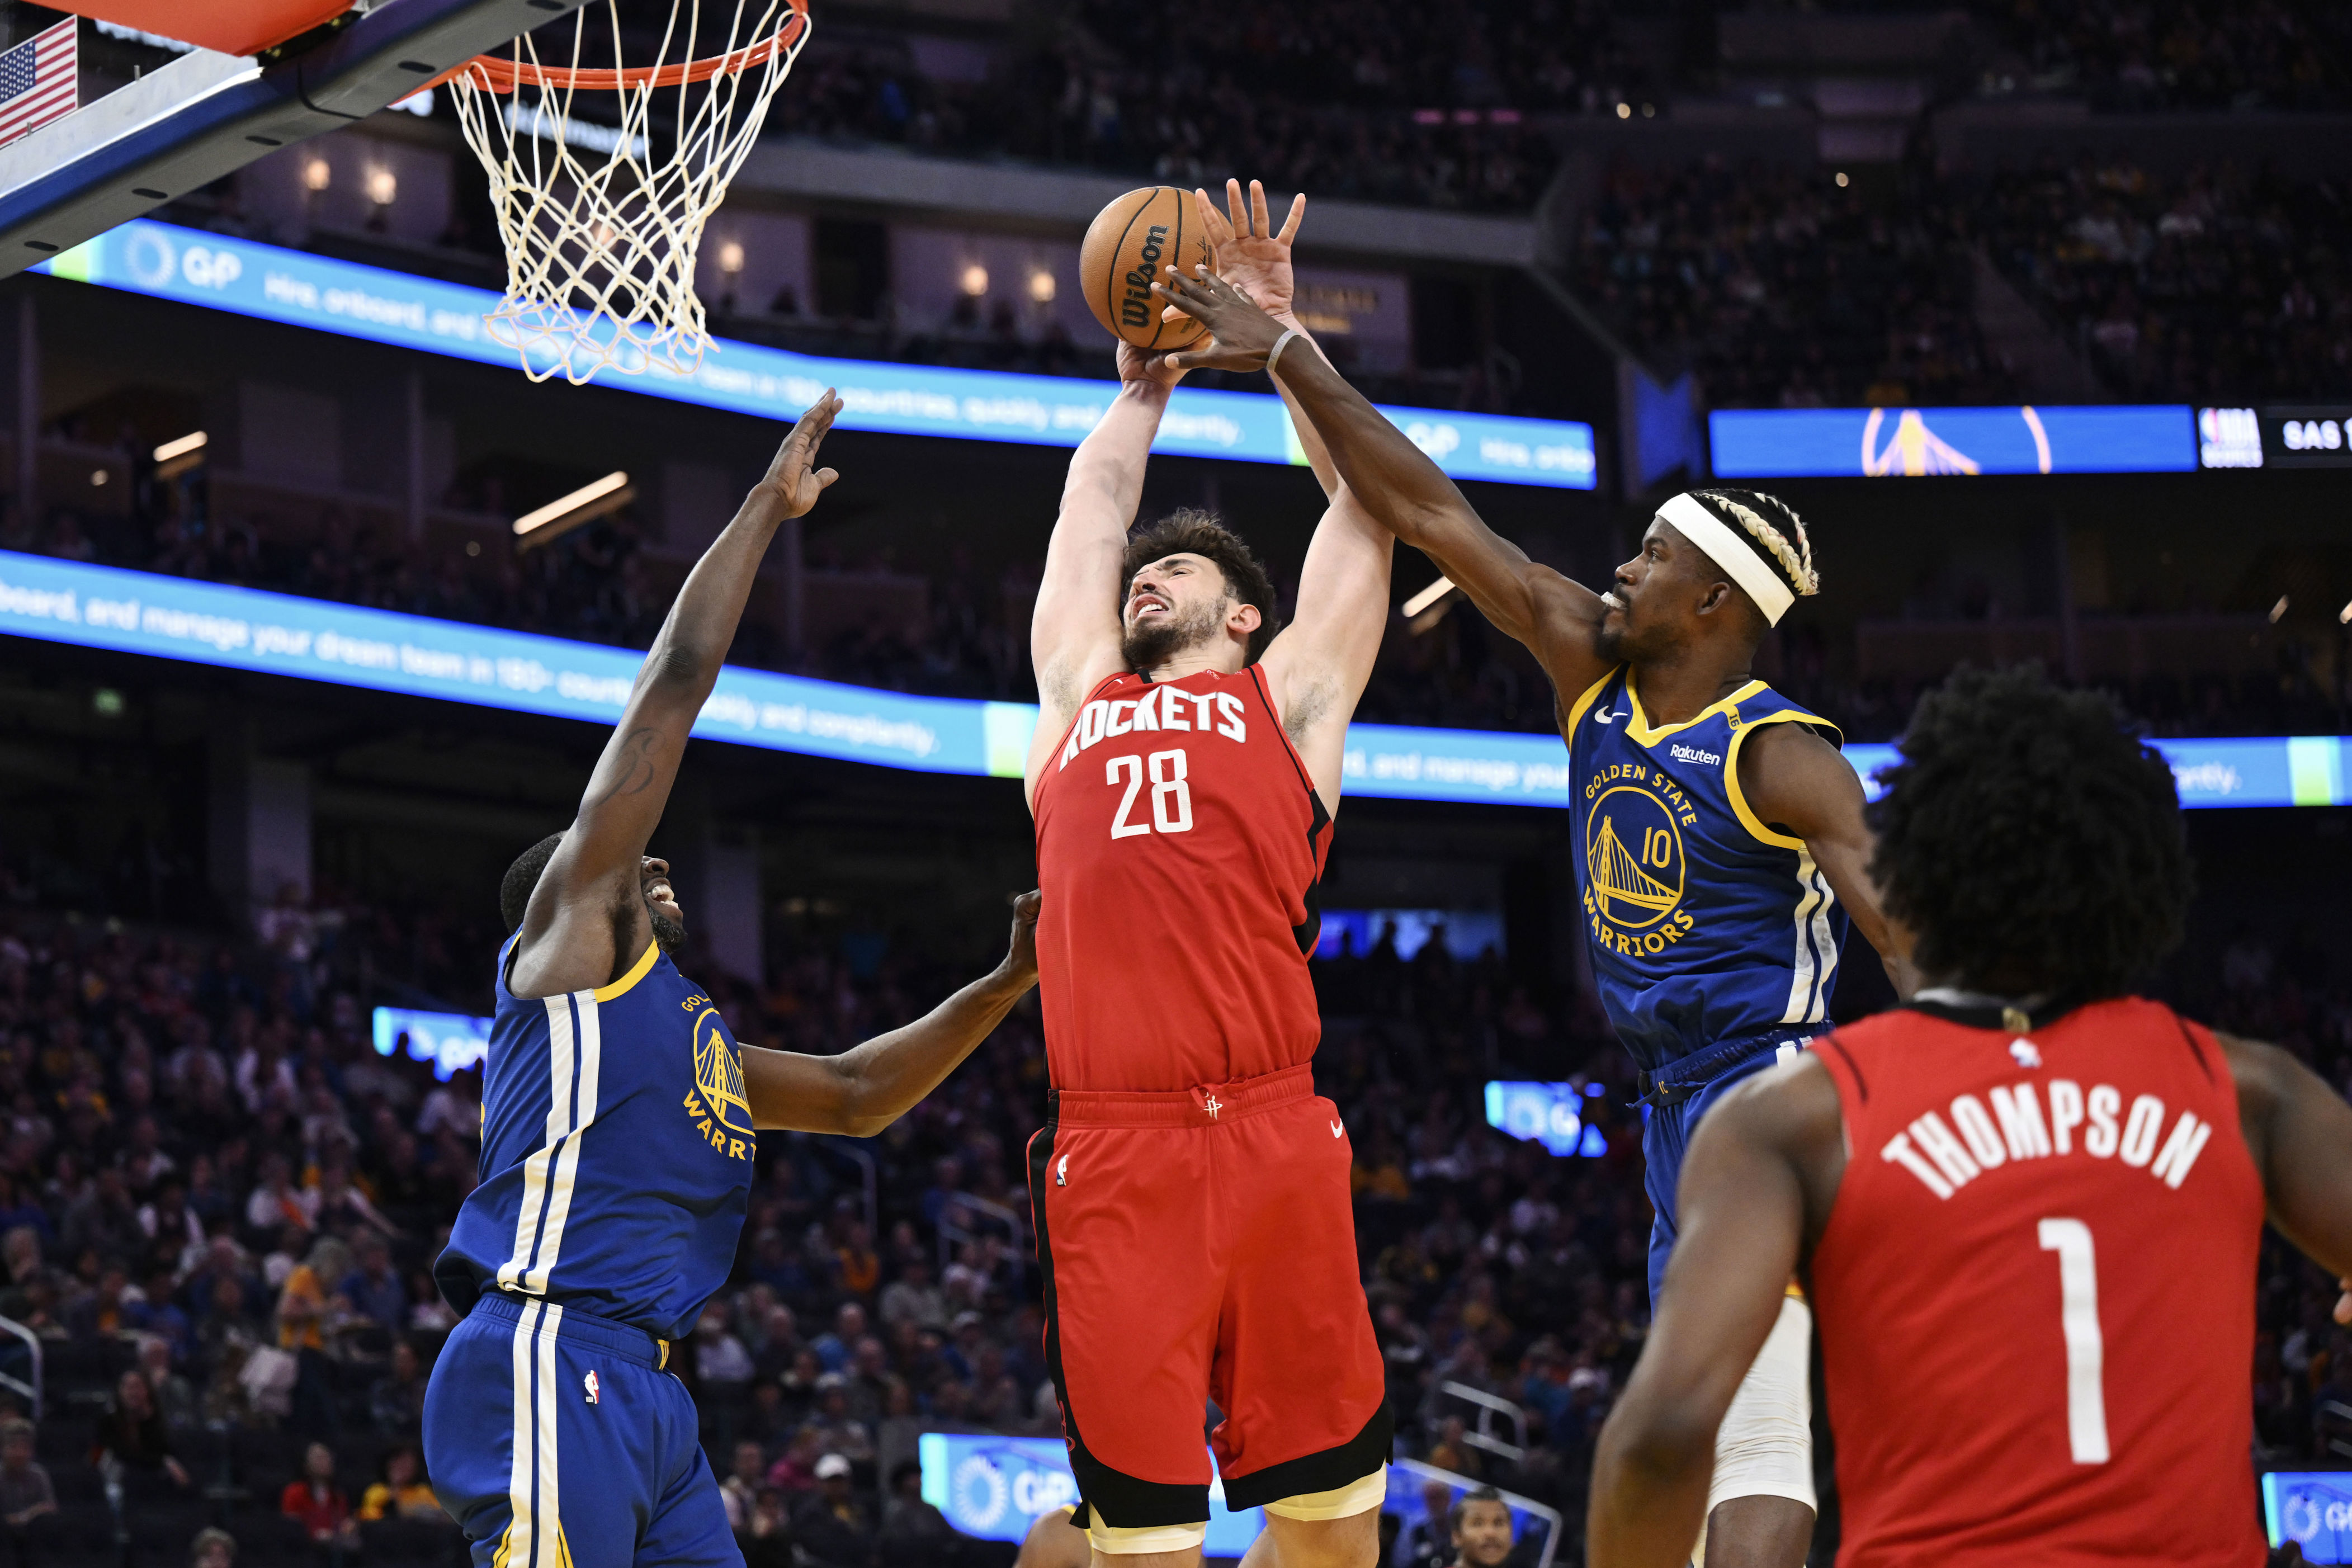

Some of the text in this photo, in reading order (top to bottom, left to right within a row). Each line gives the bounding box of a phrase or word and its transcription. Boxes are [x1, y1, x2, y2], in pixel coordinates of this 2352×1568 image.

[1122, 225, 1169, 328] Wilson
[1059, 684, 1246, 773] ROCKETS
[1670, 744, 1721, 766] Rakuten
[1106, 749, 1193, 840] 28
[1586, 764, 1698, 826] GOLDEN STATE
[1642, 826, 1671, 868] 10
[1583, 885, 1695, 957] WARRIORS
[682, 994, 712, 1012] GOL
[683, 1088, 757, 1163] WARRI
[1881, 1079, 2212, 1201] THOMPSON
[2037, 1218, 2110, 1465] 1
